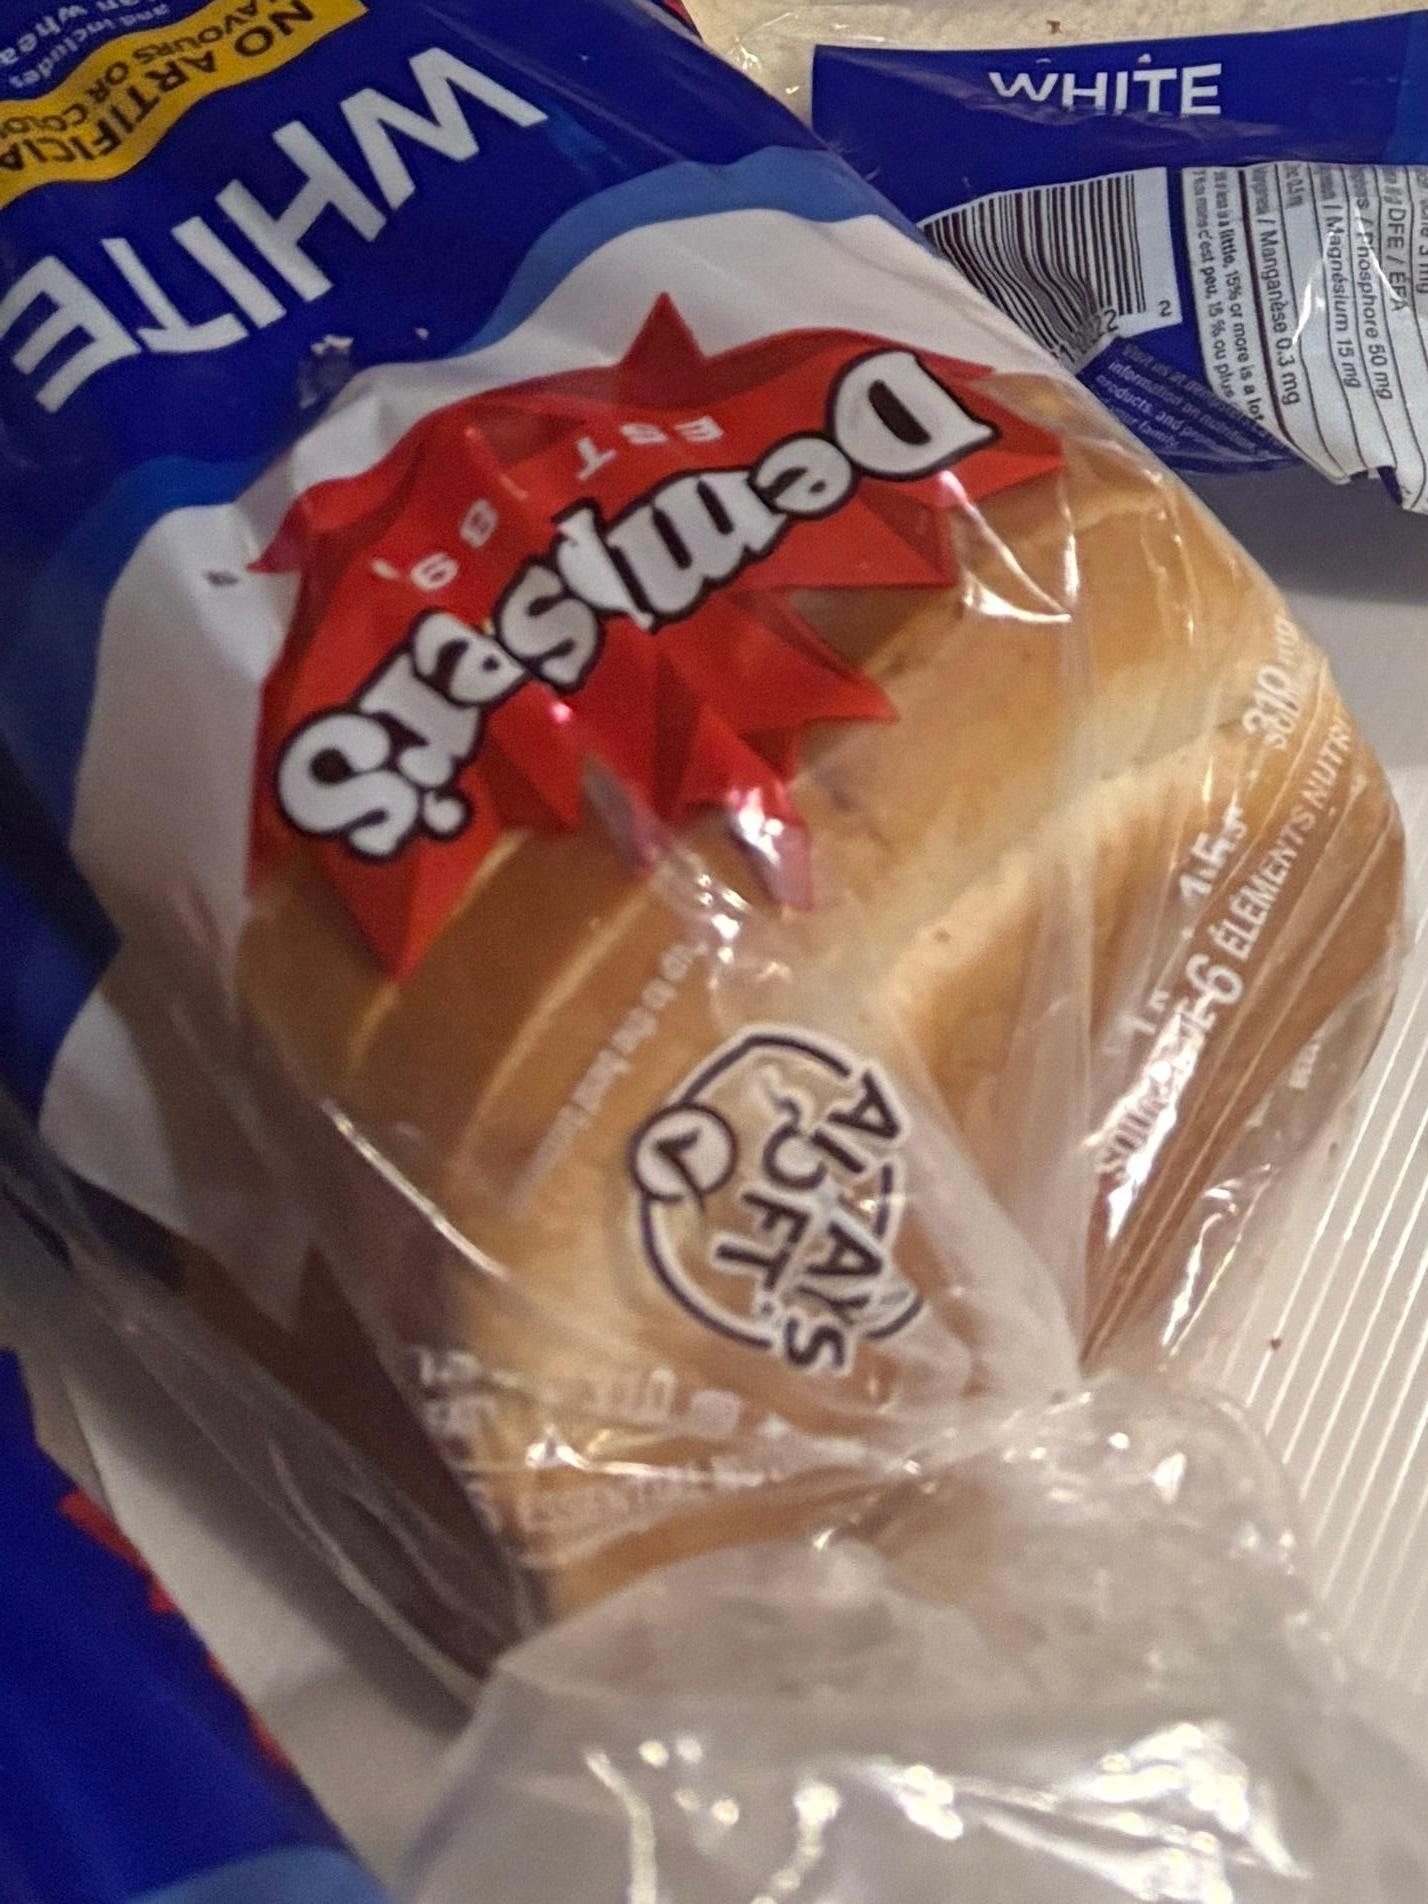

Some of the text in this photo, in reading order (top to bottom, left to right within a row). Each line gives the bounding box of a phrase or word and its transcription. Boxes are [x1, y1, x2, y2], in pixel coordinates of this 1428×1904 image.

[0, 4, 87, 67] whea
[9, 4, 171, 88] and includes
[0, 0, 314, 171] NO ARTIFICIA
[86, 61, 129, 103] OR
[988, 63, 1222, 116] WHITE
[0, 47, 549, 414] WHITE
[1386, 207, 1407, 250] DFE
[1158, 300, 1172, 317] 2
[1260, 230, 1301, 406] Manganèse 0.3 mg
[1325, 216, 1362, 389] Magnésium 15 mg
[1215, 365, 1234, 397] plus
[1233, 323, 1249, 363] more
[1248, 398, 1264, 422] lot
[1369, 341, 1387, 367] 50
[1374, 370, 1393, 401] mg
[573, 416, 724, 481] EST
[1156, 409, 1184, 430] and
[277, 349, 1000, 864] Dempster's
[1185, 954, 1243, 1006] 6
